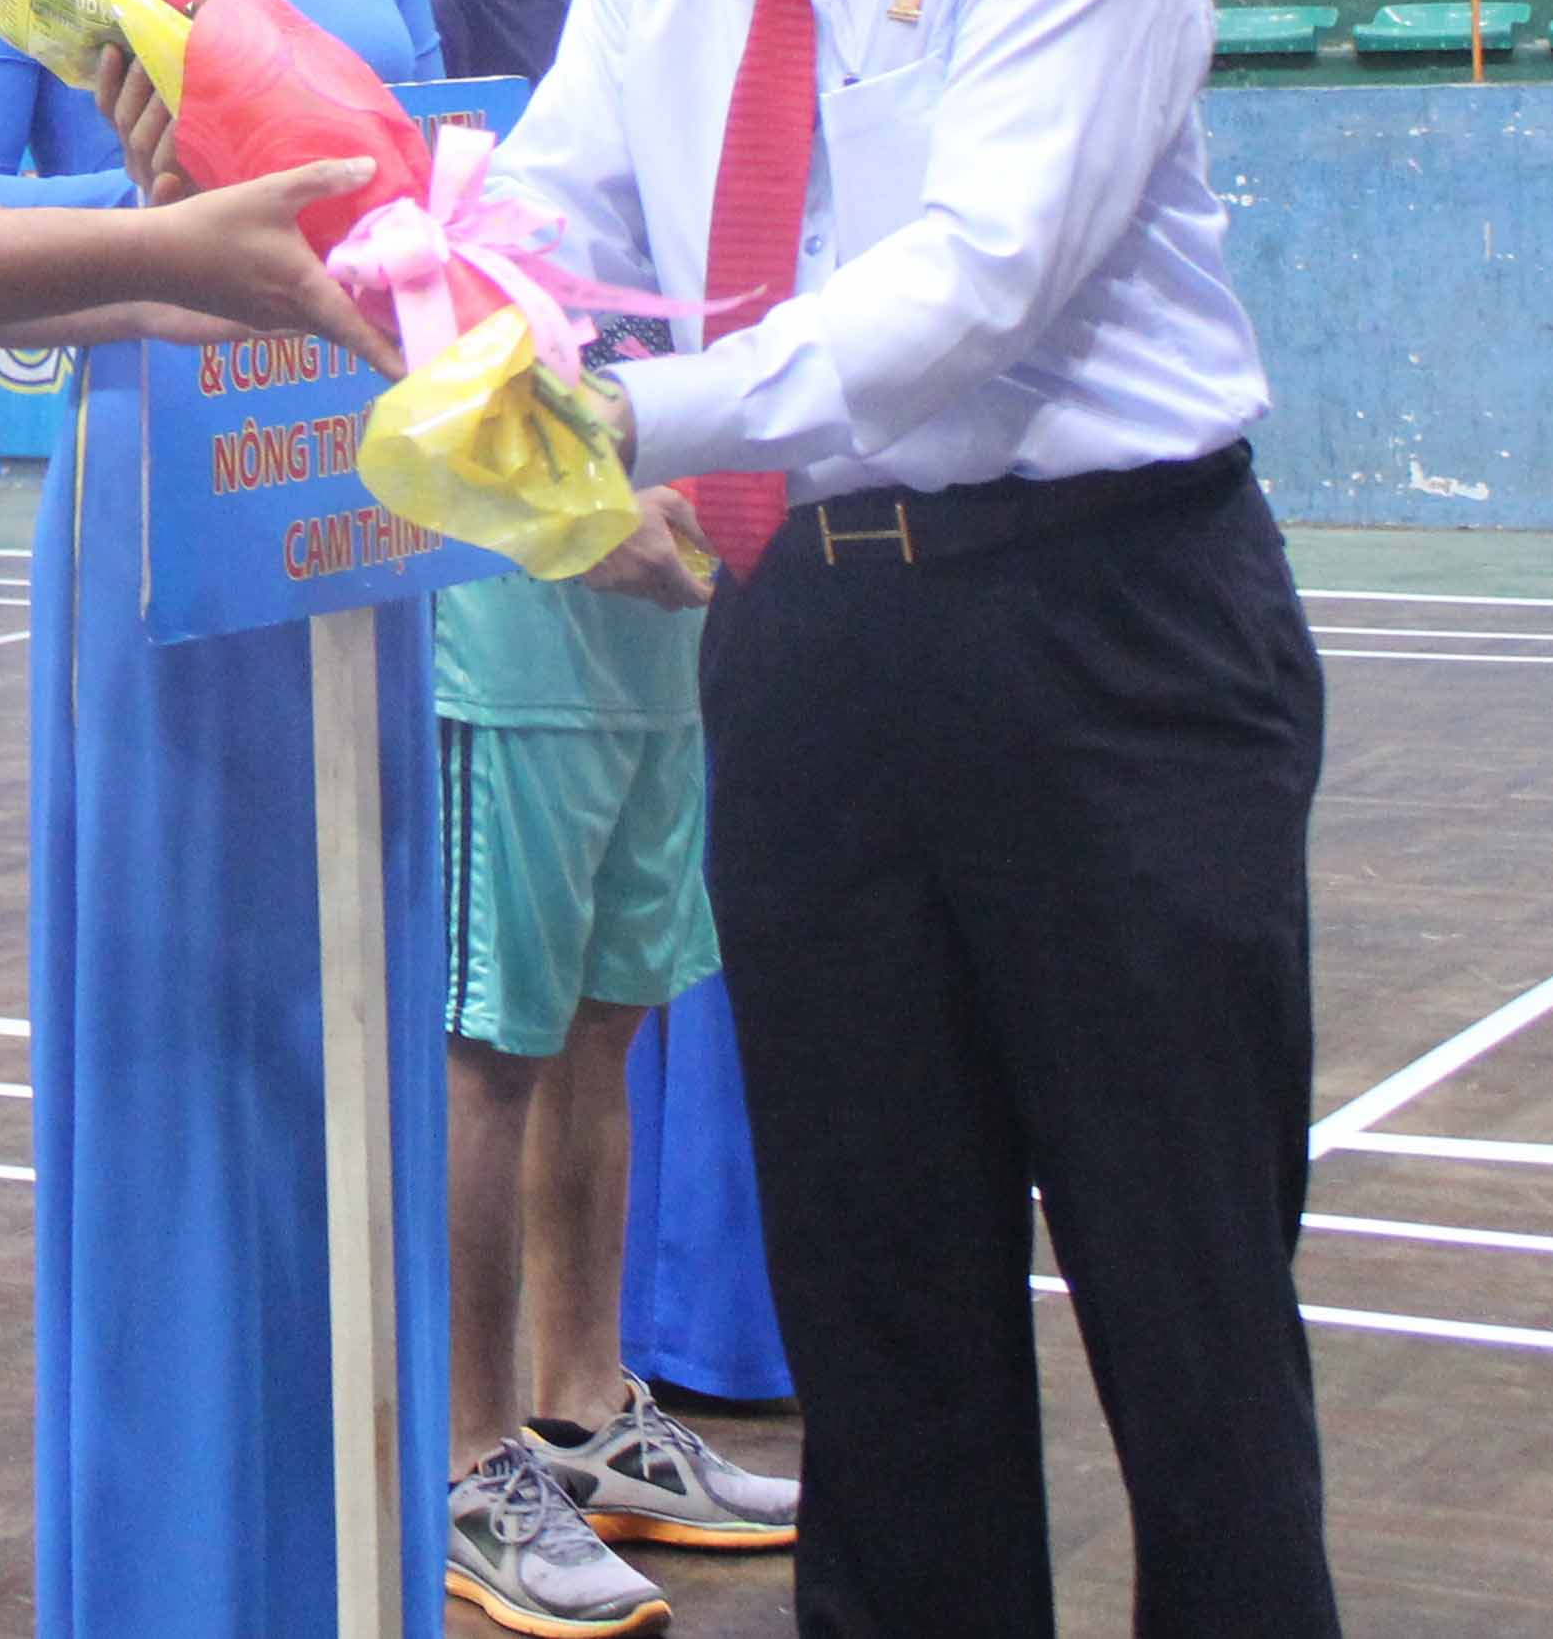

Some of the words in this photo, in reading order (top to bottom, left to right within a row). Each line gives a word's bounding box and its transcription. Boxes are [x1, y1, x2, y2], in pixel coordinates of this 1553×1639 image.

[200, 342, 227, 396] &
[213, 416, 310, 495] NÔNG
[285, 508, 353, 581] CAM
